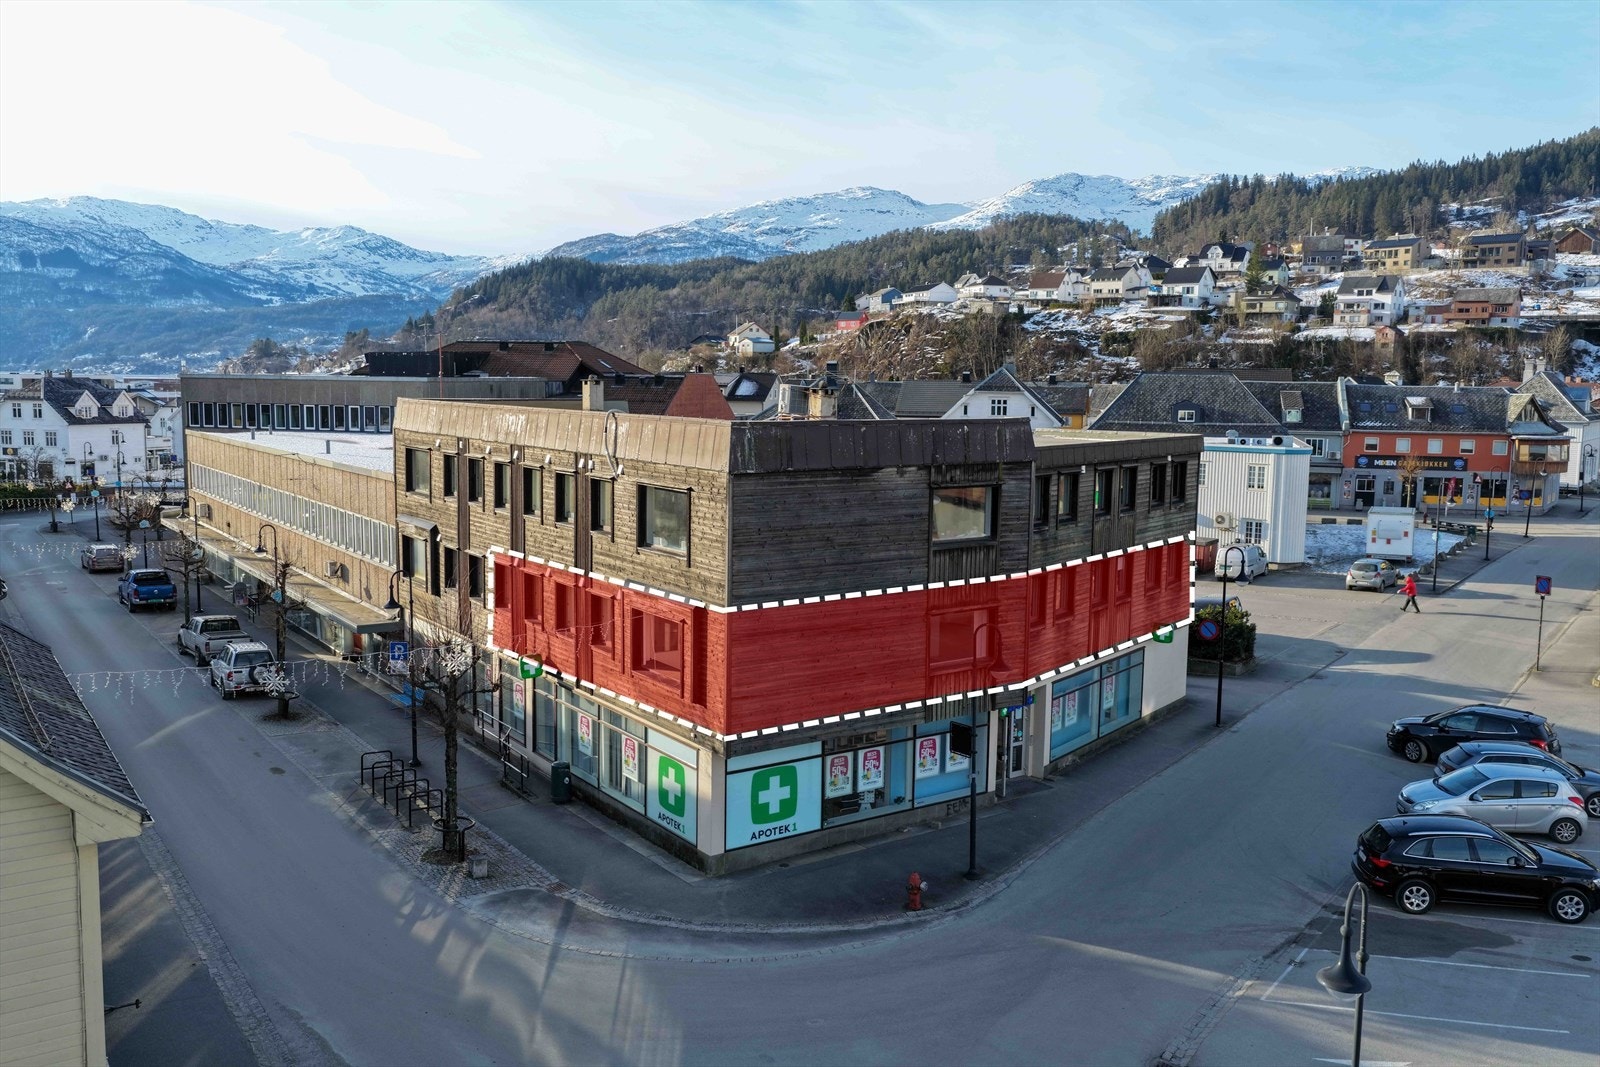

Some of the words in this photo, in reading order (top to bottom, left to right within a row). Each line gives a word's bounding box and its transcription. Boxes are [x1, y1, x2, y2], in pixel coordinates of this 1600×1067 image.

[395, 645, 404, 658] P
[658, 812, 681, 832] APOTEK
[750, 824, 791, 841] APOTEK
[791, 822, 798, 832] 1
